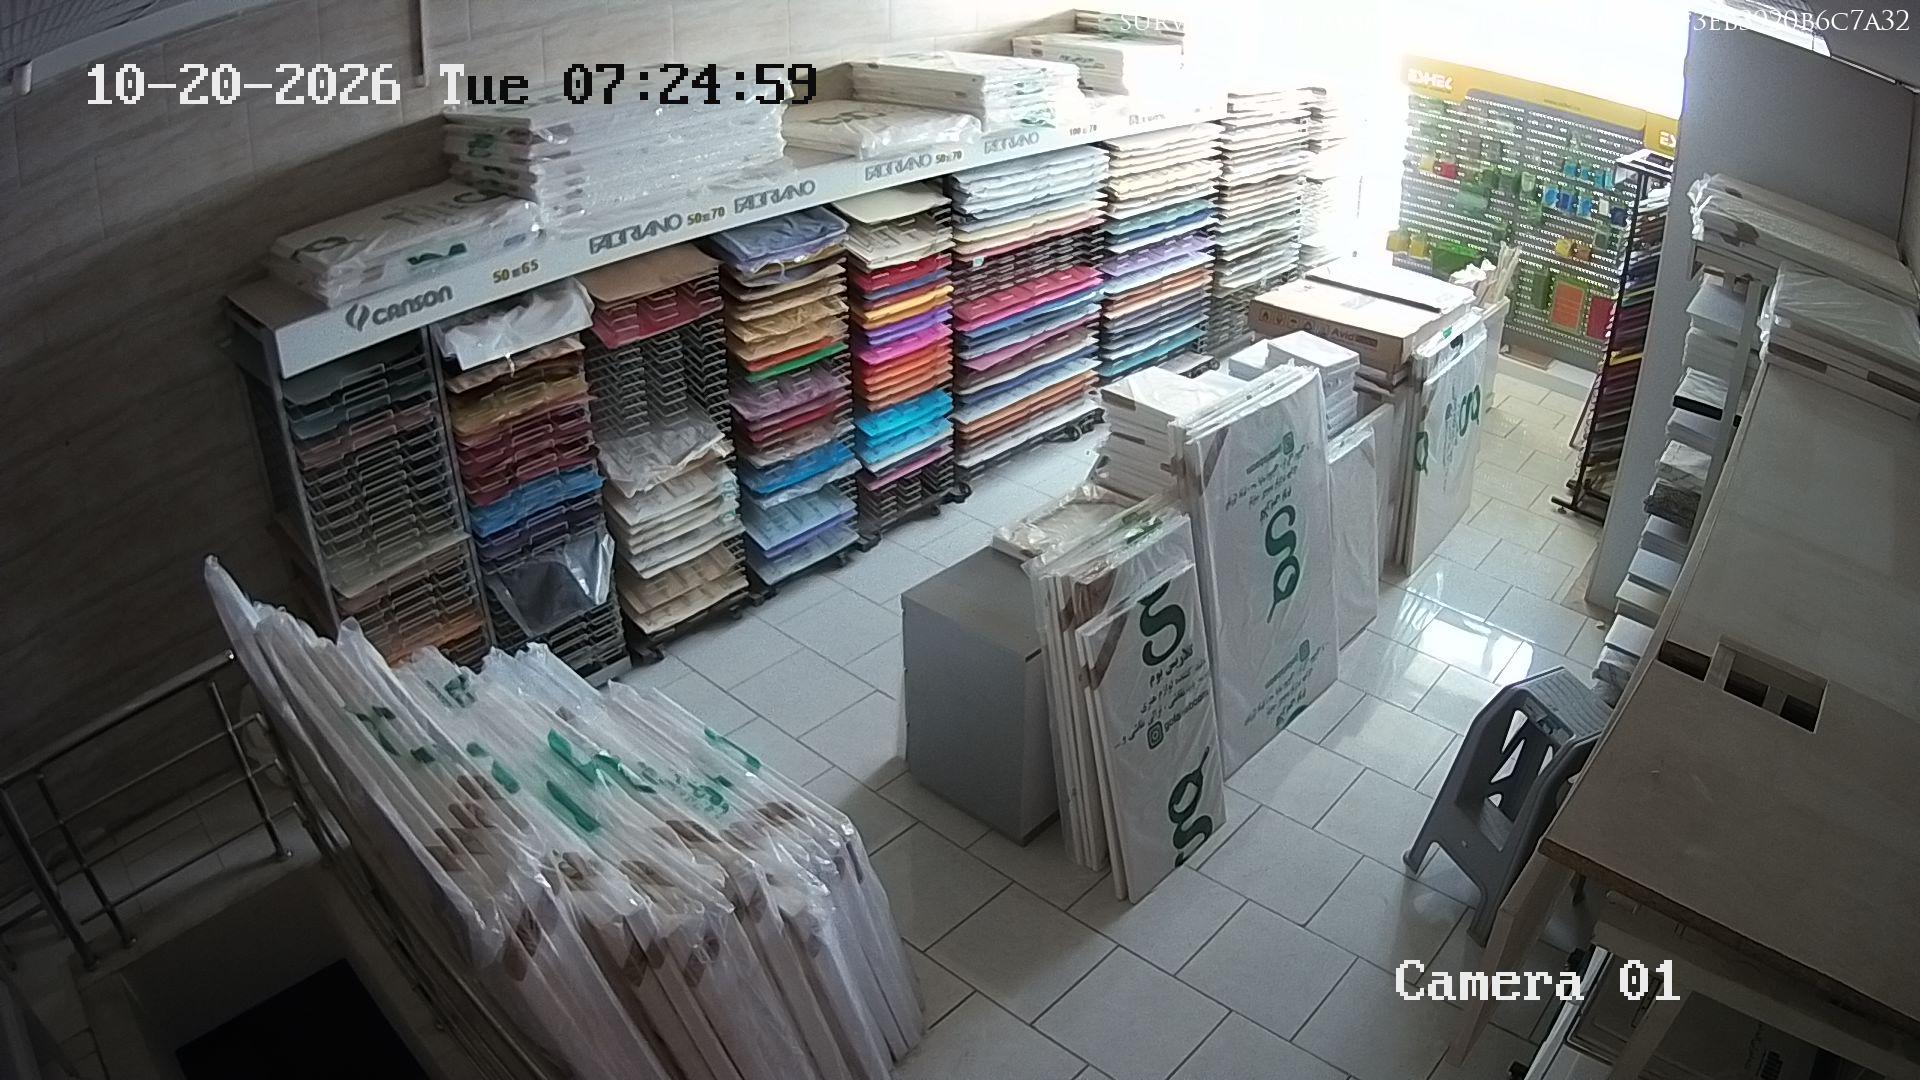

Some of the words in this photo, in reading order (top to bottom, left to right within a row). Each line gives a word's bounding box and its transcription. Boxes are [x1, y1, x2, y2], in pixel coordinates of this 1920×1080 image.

[865, 153, 933, 181] FABRIANO
[734, 179, 816, 214] FABRIANO
[589, 213, 683, 255] FABRIANO
